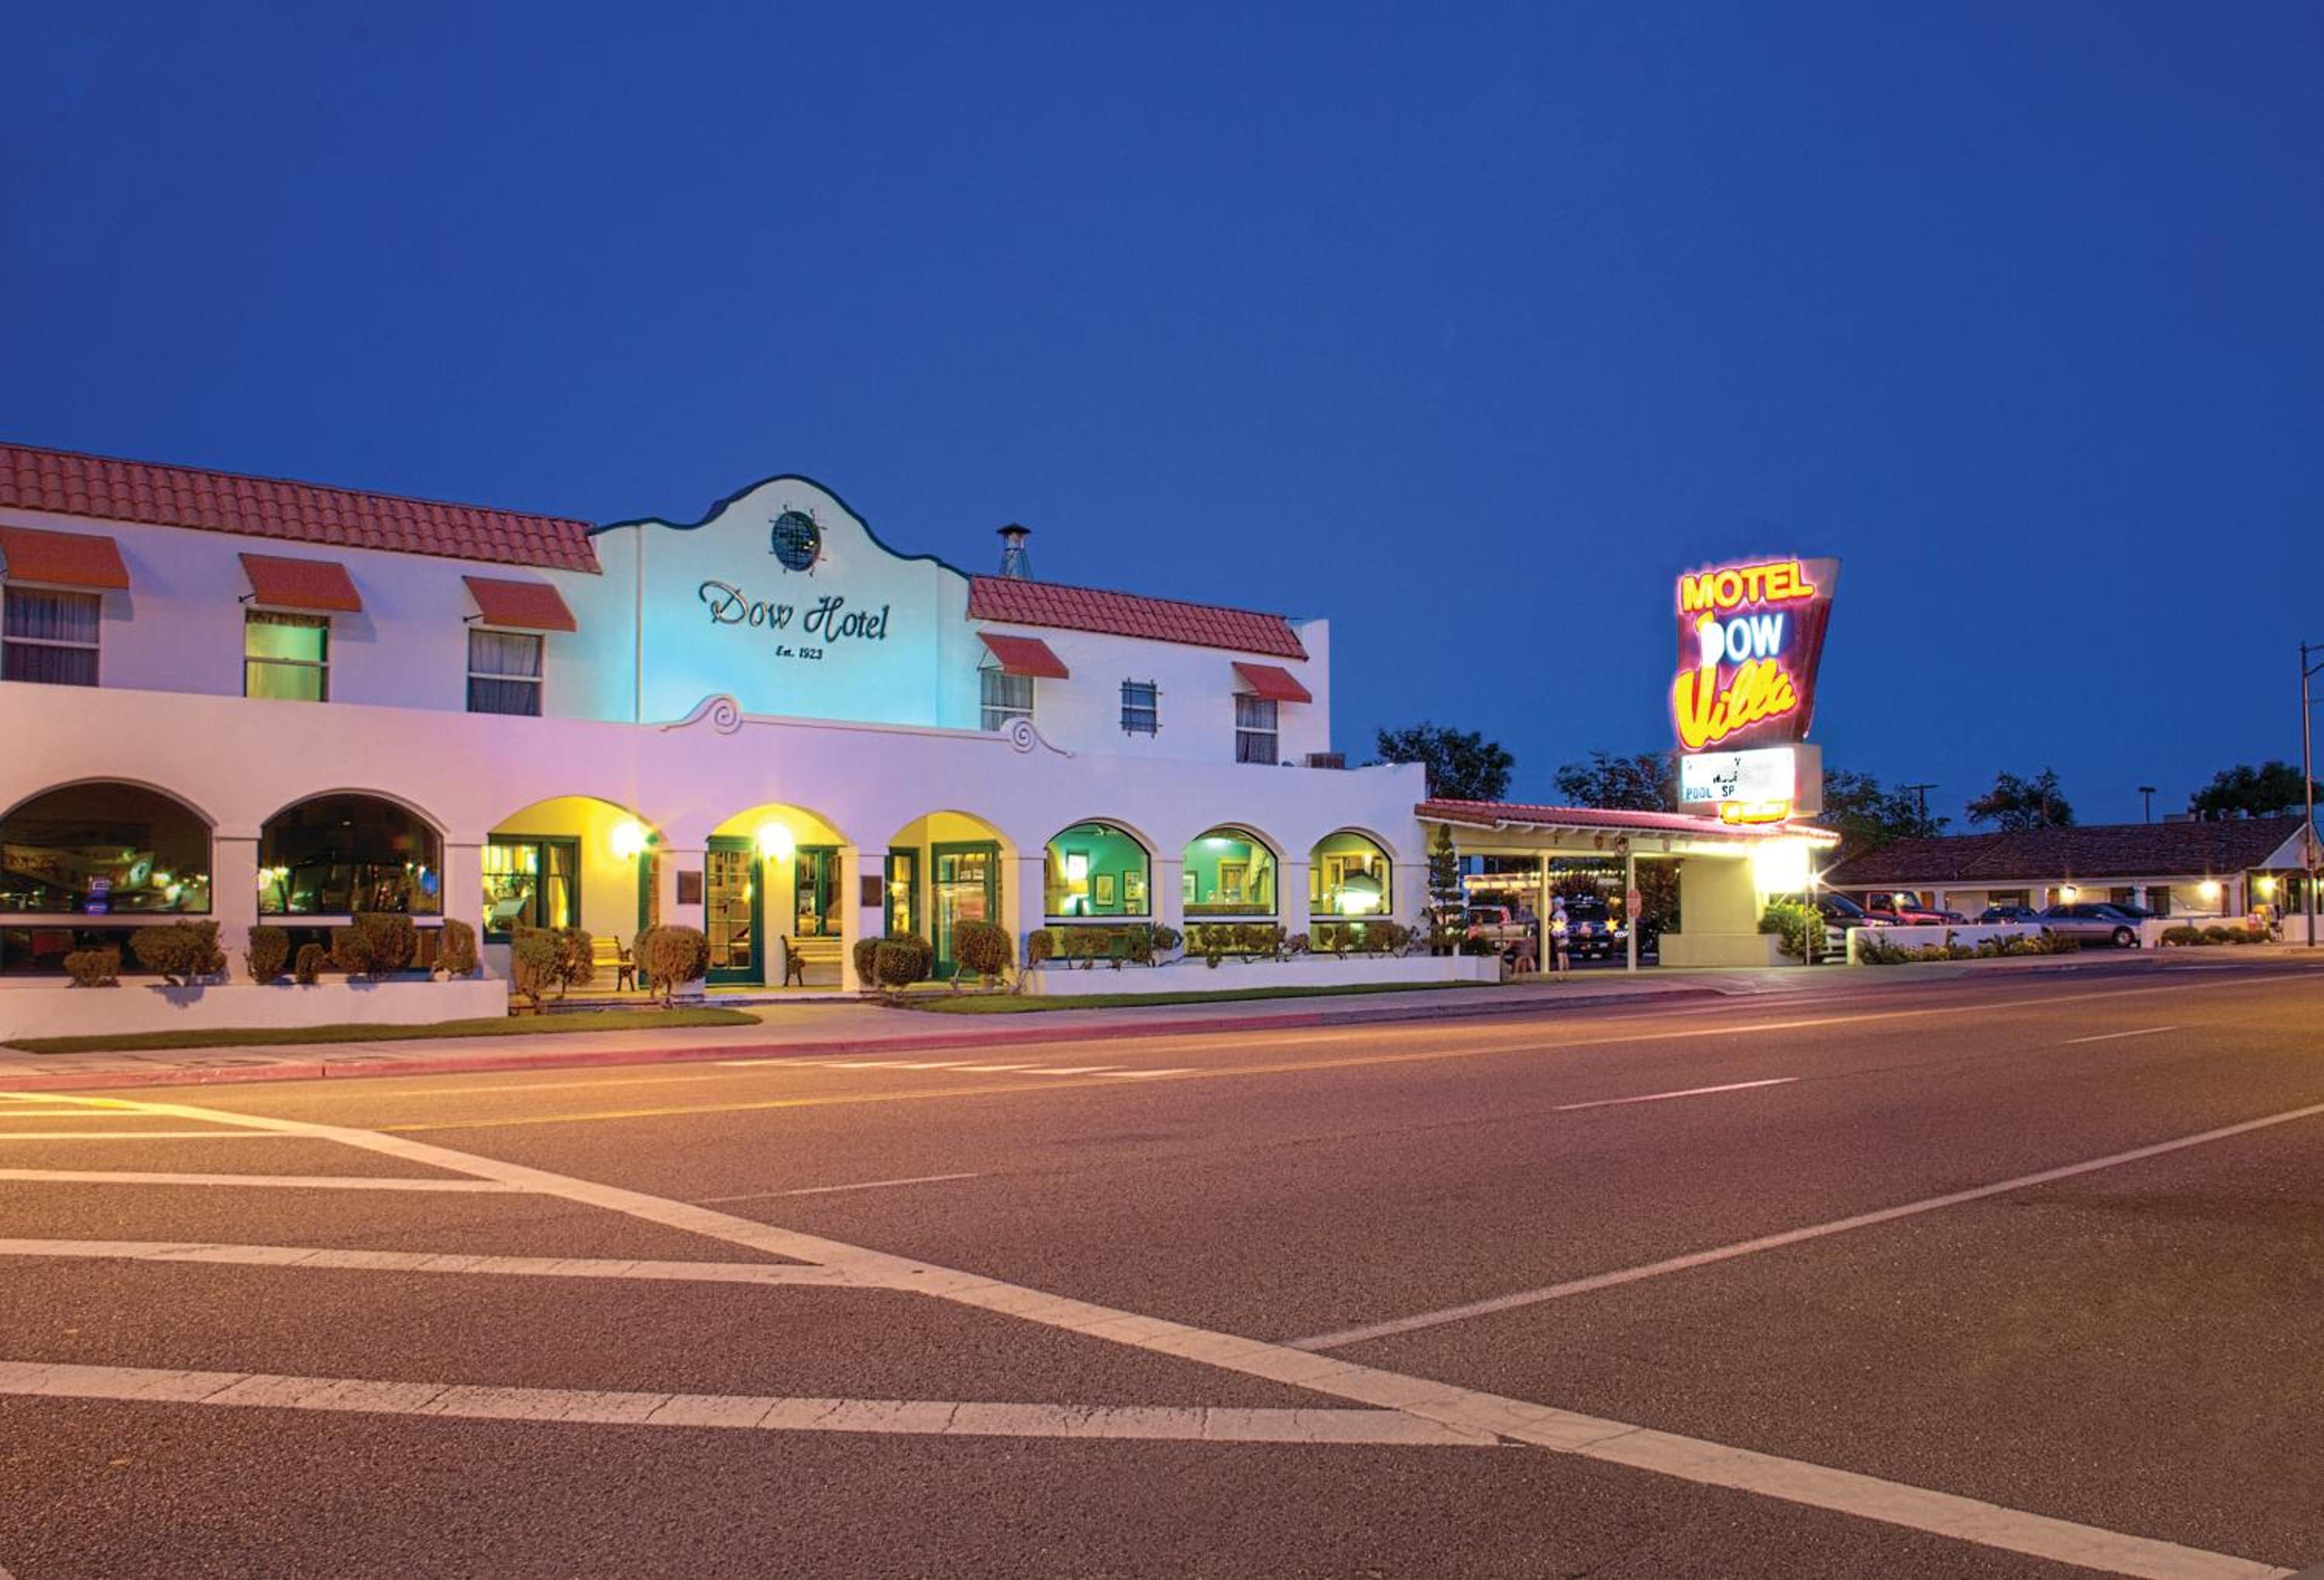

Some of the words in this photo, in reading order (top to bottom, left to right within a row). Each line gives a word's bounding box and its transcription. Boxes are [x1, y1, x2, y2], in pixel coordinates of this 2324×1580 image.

[699, 580, 793, 629] Dow
[803, 594, 890, 643] Hotel
[1682, 561, 1814, 611] MOTEL
[1699, 613, 1784, 665] DOW
[1675, 658, 1797, 748] Villa
[1685, 786, 1713, 800] POOL
